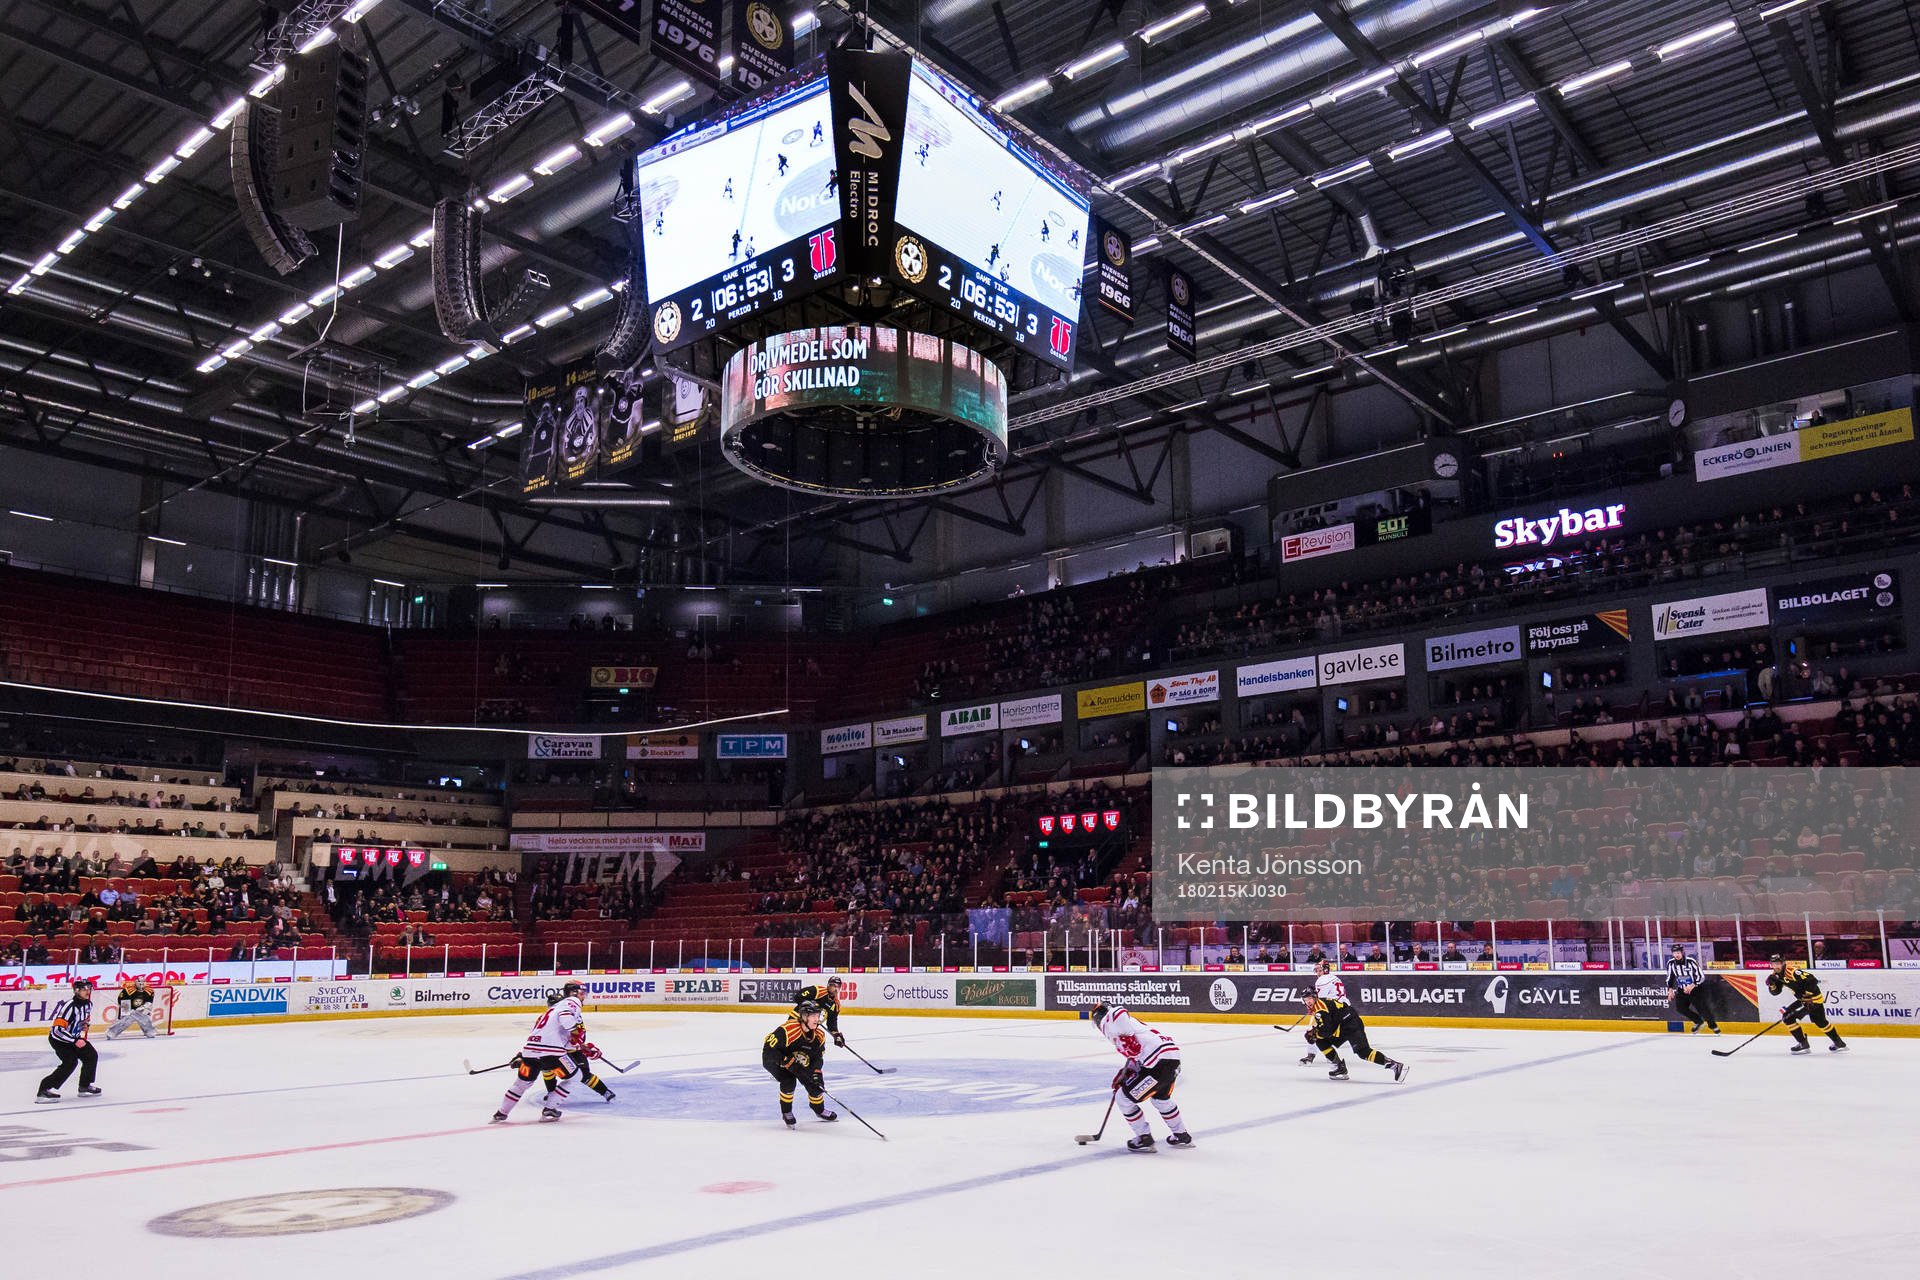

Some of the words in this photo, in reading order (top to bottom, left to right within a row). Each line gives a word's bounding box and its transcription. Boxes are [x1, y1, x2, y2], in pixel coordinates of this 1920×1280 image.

[656, 18, 715, 64] 1976
[741, 42, 788, 73] SVENSKA
[849, 170, 860, 218] Electro
[868, 171, 879, 247] MIDROC
[722, 269, 739, 282] GAME
[741, 261, 757, 276] TIME
[781, 258, 794, 282] 3
[813, 266, 837, 281] ÖREBRO
[938, 265, 952, 291] 2
[1101, 263, 1128, 283] SVENSKA
[976, 271, 991, 285] GAME
[994, 281, 1009, 297] TIME
[1101, 270, 1129, 291] MÄSTARE
[715, 269, 769, 311] 06:53
[773, 289, 783, 302] 18
[1100, 282, 1131, 309] 1966
[950, 296, 961, 310] 20
[963, 278, 1016, 325] 06:53
[691, 298, 703, 322] 2
[728, 304, 752, 320] PERIOD
[754, 301, 759, 310] 2
[705, 317, 716, 330] 20
[973, 310, 996, 330] PERIOD
[998, 323, 1003, 332] 2
[1026, 313, 1038, 336] 3
[1015, 331, 1025, 343] 18
[1168, 322, 1194, 346] 1964
[750, 340, 828, 376] DRIVMEDEL
[831, 338, 867, 360] SOM
[754, 370, 780, 400] GÖR
[783, 365, 860, 393] SKILLNAD
[1702, 451, 1743, 467] ECKERÖ
[1756, 441, 1792, 456] LINJEN
[1494, 503, 1625, 549] Skybar
[1301, 529, 1351, 550] Revision
[1377, 530, 1409, 542] KONSULT
[1779, 587, 1869, 611] BILBOLAGET
[1670, 605, 1707, 621] Svensk
[1529, 626, 1551, 641] Följ
[1552, 625, 1572, 636] oss
[1572, 621, 1589, 636] på
[1676, 618, 1704, 631] Cater
[1430, 639, 1514, 664] Bilmetro
[1324, 653, 1399, 681] gavle.se
[613, 668, 655, 683] BIG
[1206, 674, 1217, 682] AB
[1238, 667, 1315, 687] Handelsbanken
[1096, 692, 1141, 706] Ramudden
[1178, 688, 1192, 697] SÅG
[1198, 686, 1217, 695] BORR
[542, 740, 593, 750] Caravan
[551, 748, 594, 758] Marine
[673, 979, 723, 994] PEAB
[759, 981, 801, 991] REKLAM
[897, 986, 949, 1000] nettbuss
[1056, 980, 1127, 993] Tillsammans
[1127, 980, 1167, 993] sänker
[1169, 980, 1181, 993] vi
[1213, 983, 1222, 991] EN
[1213, 990, 1226, 998] BRA
[210, 987, 288, 1003] SANDVIK
[308, 995, 348, 1006] FREIGHT
[350, 992, 366, 1003] AB
[414, 990, 471, 1003] Bilmetro
[759, 991, 797, 1001] PARTNE
[998, 995, 1030, 1005] BAGERI
[1056, 993, 1190, 1006] ungdomsarbetslösheten
[1214, 998, 1233, 1006] START
[1360, 988, 1466, 1004] BILBOLAGET
[1519, 986, 1581, 1005] GÄVLE
[1620, 996, 1670, 1009] Gävleborg
[1839, 991, 1848, 1000] &
[1849, 990, 1897, 1001] Perssons
[1847, 1007, 1881, 1017] SILJA
[1884, 1008, 1912, 1018] LINE
